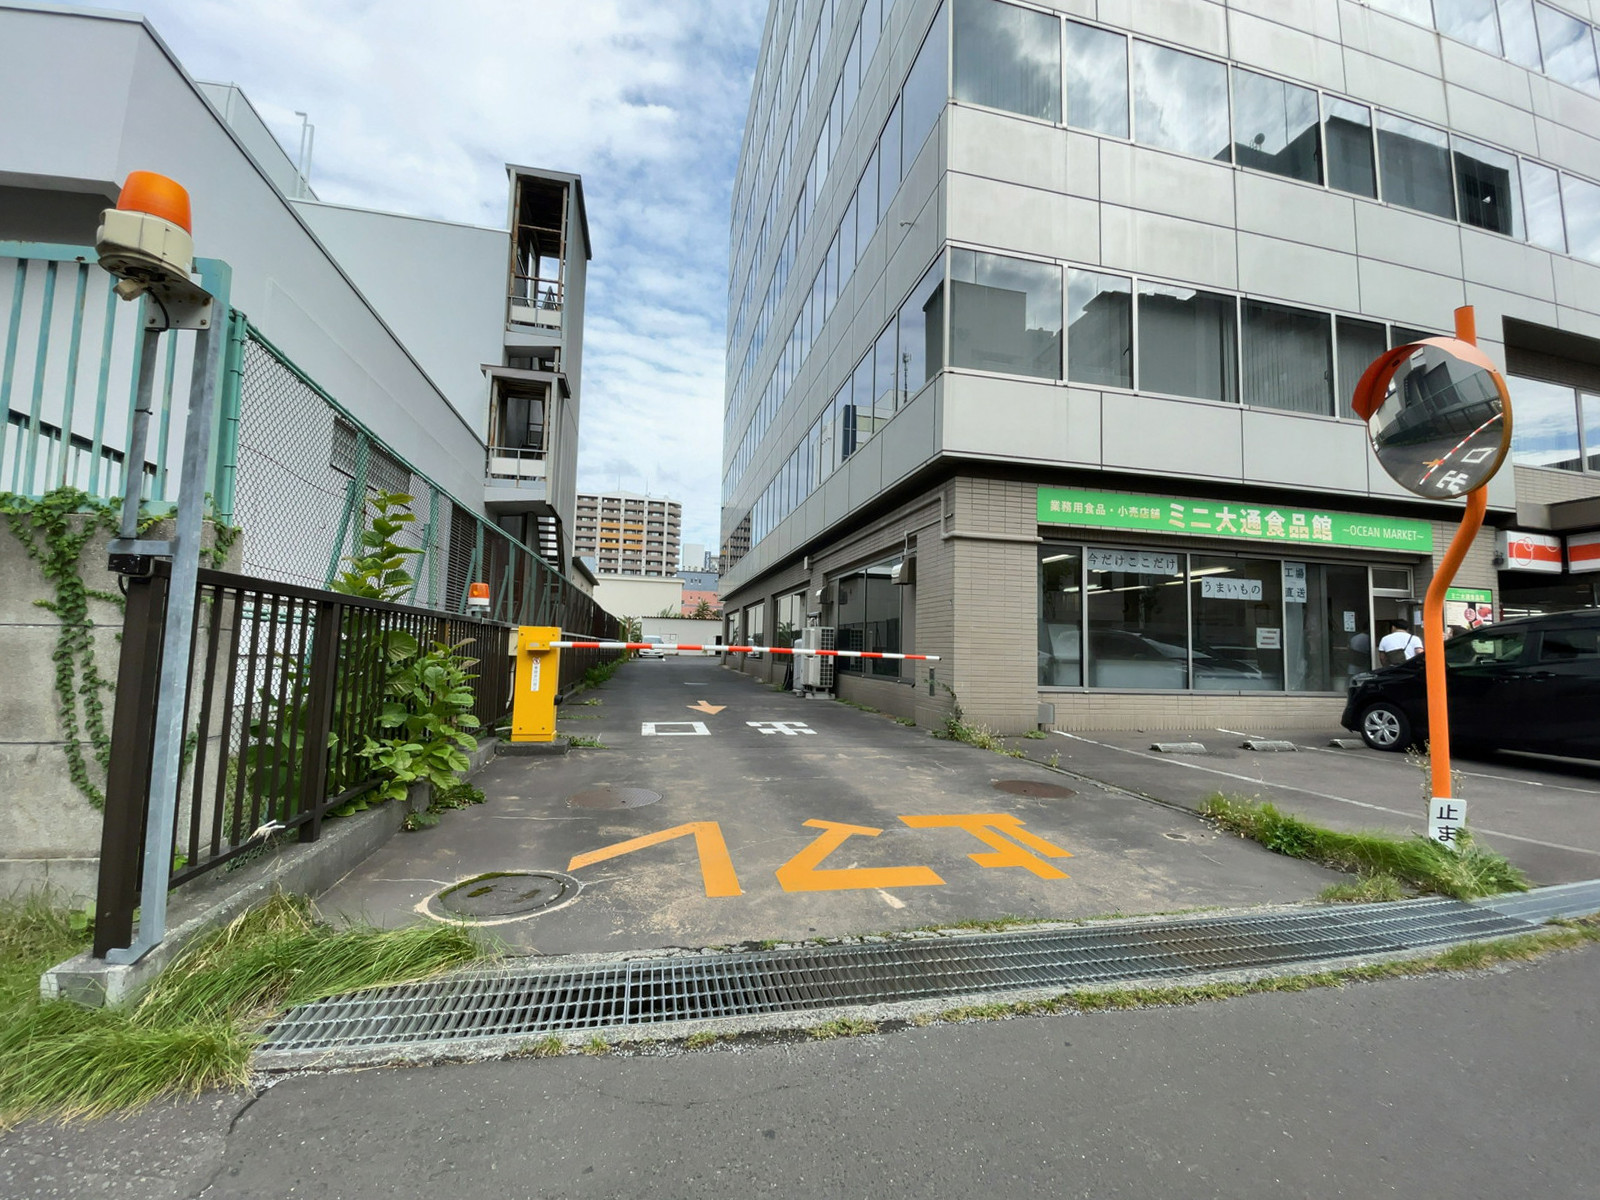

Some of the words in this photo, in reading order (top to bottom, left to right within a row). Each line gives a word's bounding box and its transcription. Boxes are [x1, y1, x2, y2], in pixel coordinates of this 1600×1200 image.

[1049, 499, 1161, 521] 業務用食品・小売店舗
[1168, 503, 1333, 541] ミニ大通食品館
[1087, 552, 1176, 570] 今だけここだけ
[1204, 580, 1261, 595] うまいもの
[641, 721, 818, 736] 出口
[567, 813, 1074, 898] 止マレ
